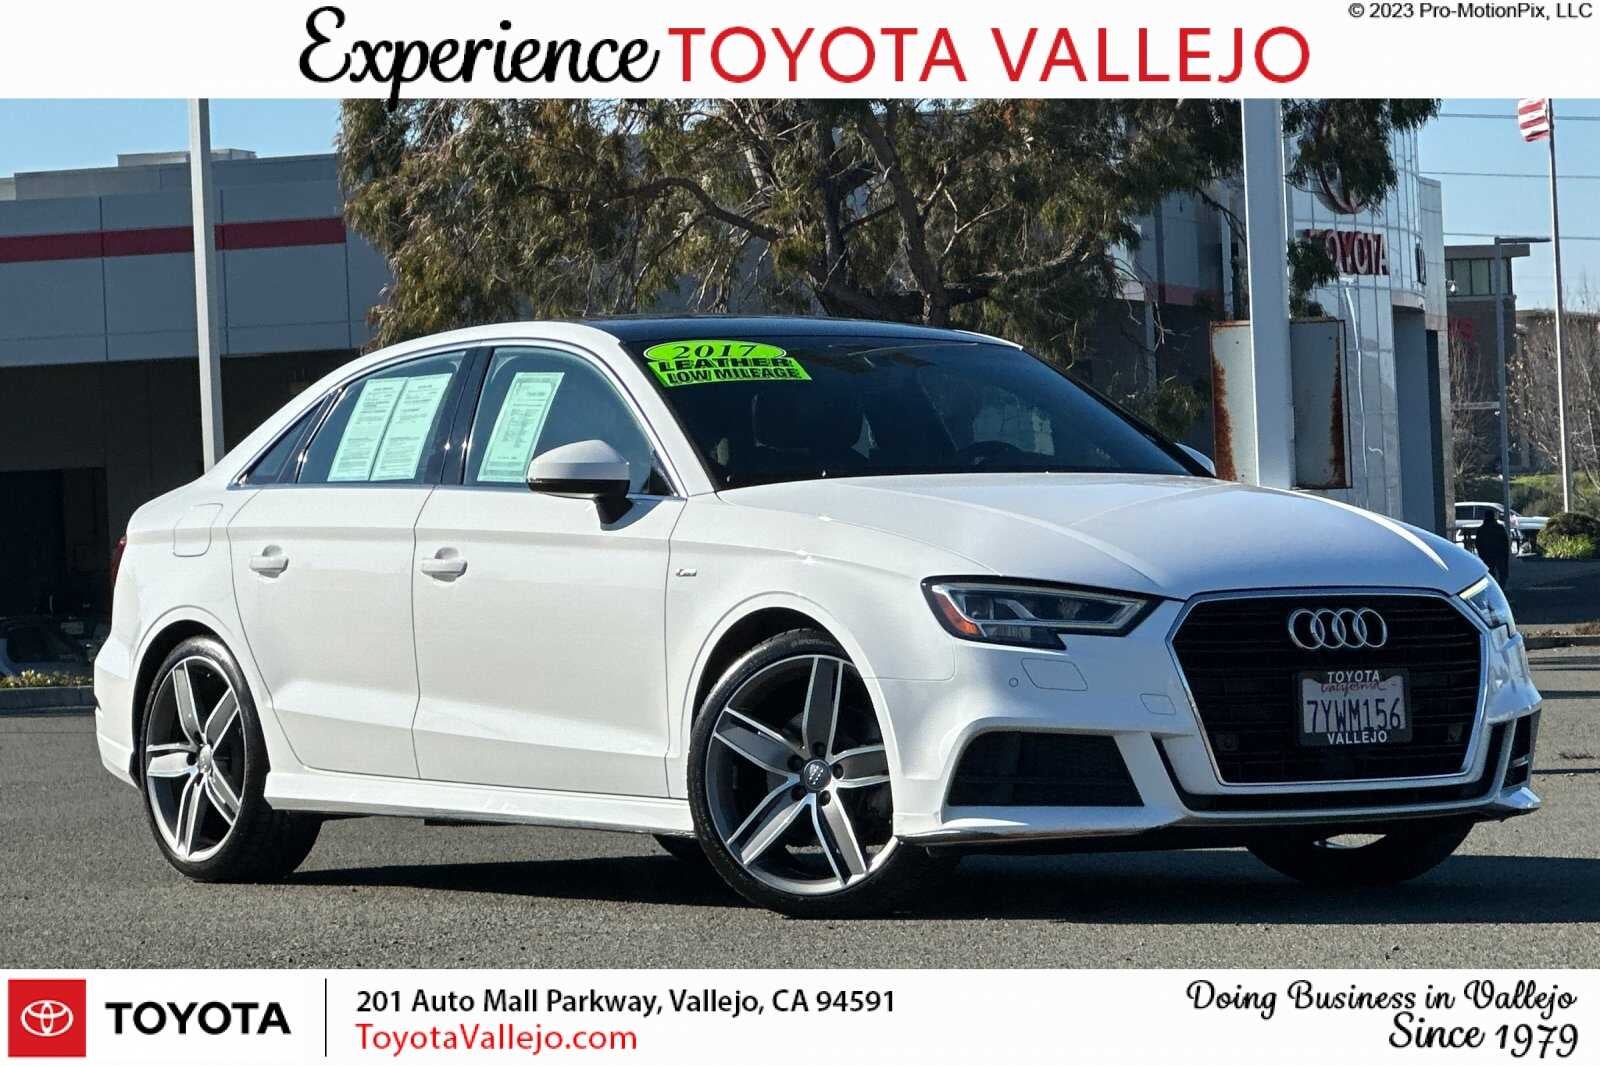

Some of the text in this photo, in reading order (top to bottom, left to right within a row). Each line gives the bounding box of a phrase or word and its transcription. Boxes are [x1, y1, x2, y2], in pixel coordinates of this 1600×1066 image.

[1304, 229, 1390, 275] OYOTA
[672, 344, 758, 360] 2017
[658, 357, 792, 372] LEATHER
[666, 368, 802, 384] LOW MILEAGE
[1327, 670, 1380, 683] TOYOTA
[1307, 698, 1400, 733] 7YWM156
[1327, 731, 1388, 745] VALLEJO
